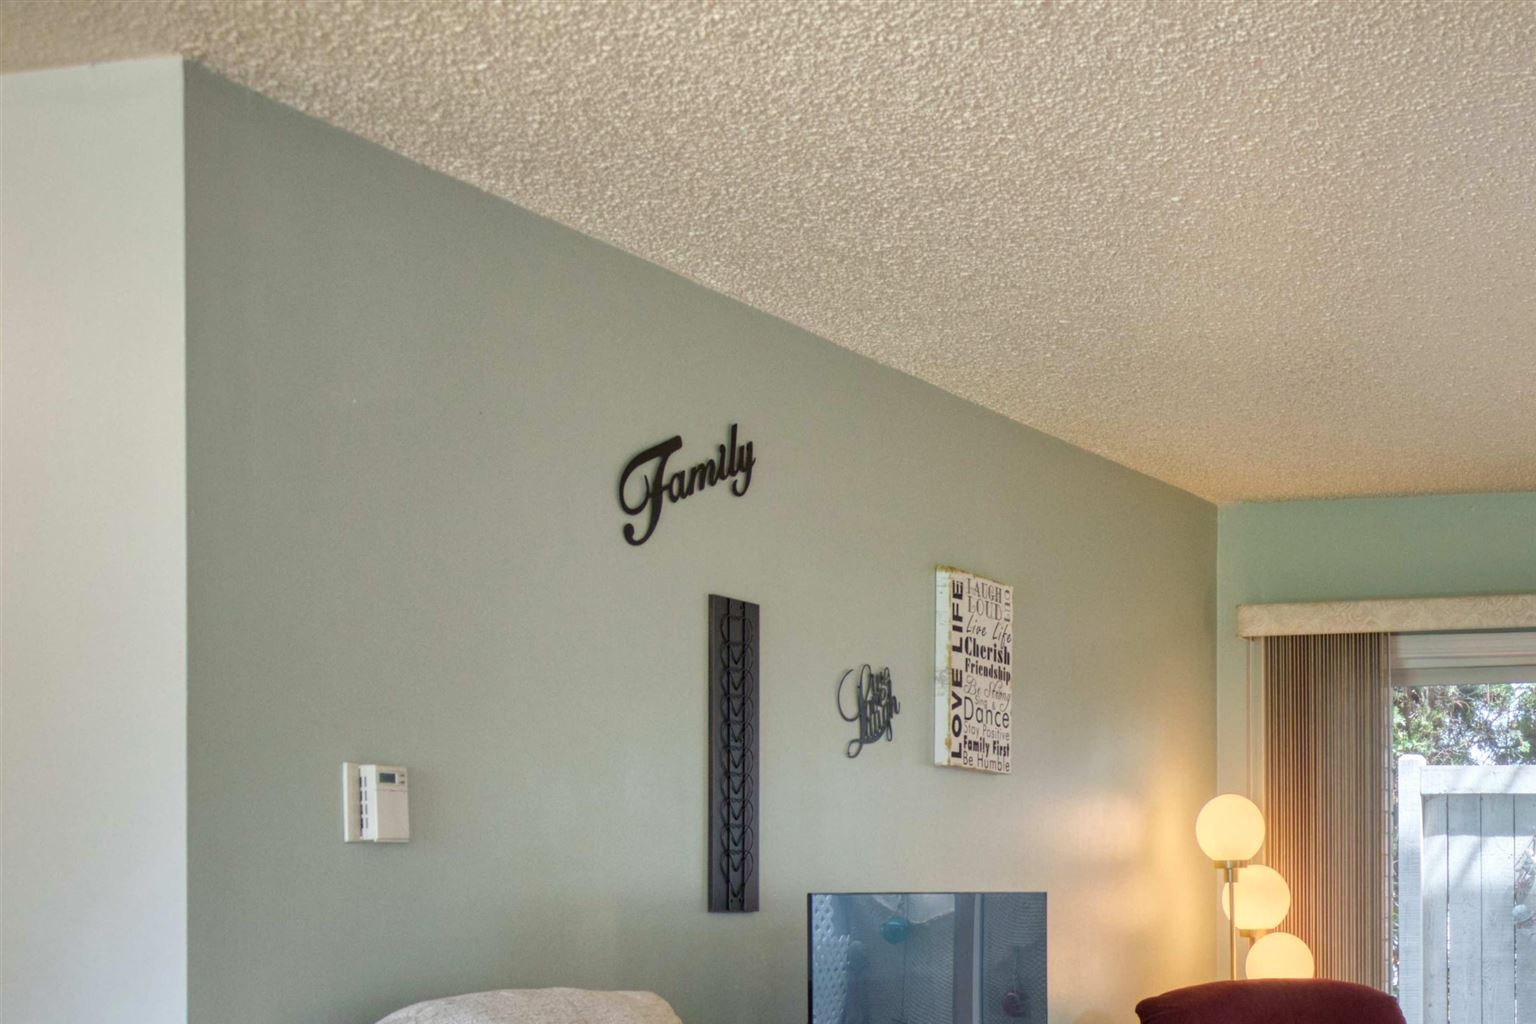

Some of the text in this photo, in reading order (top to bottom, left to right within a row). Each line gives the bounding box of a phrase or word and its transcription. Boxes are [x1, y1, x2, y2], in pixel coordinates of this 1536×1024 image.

[619, 424, 756, 546] Family
[967, 578, 1002, 604] LAUGH
[967, 595, 1003, 621] LOUD
[992, 621, 1012, 650] Life
[964, 636, 1010, 666] Cherish
[951, 579, 963, 758] LOVE LIFE
[965, 657, 1011, 686] Friendship
[963, 696, 1010, 729] Dance
[963, 735, 1010, 758] Family First
[963, 750, 1010, 773] Be Humble
